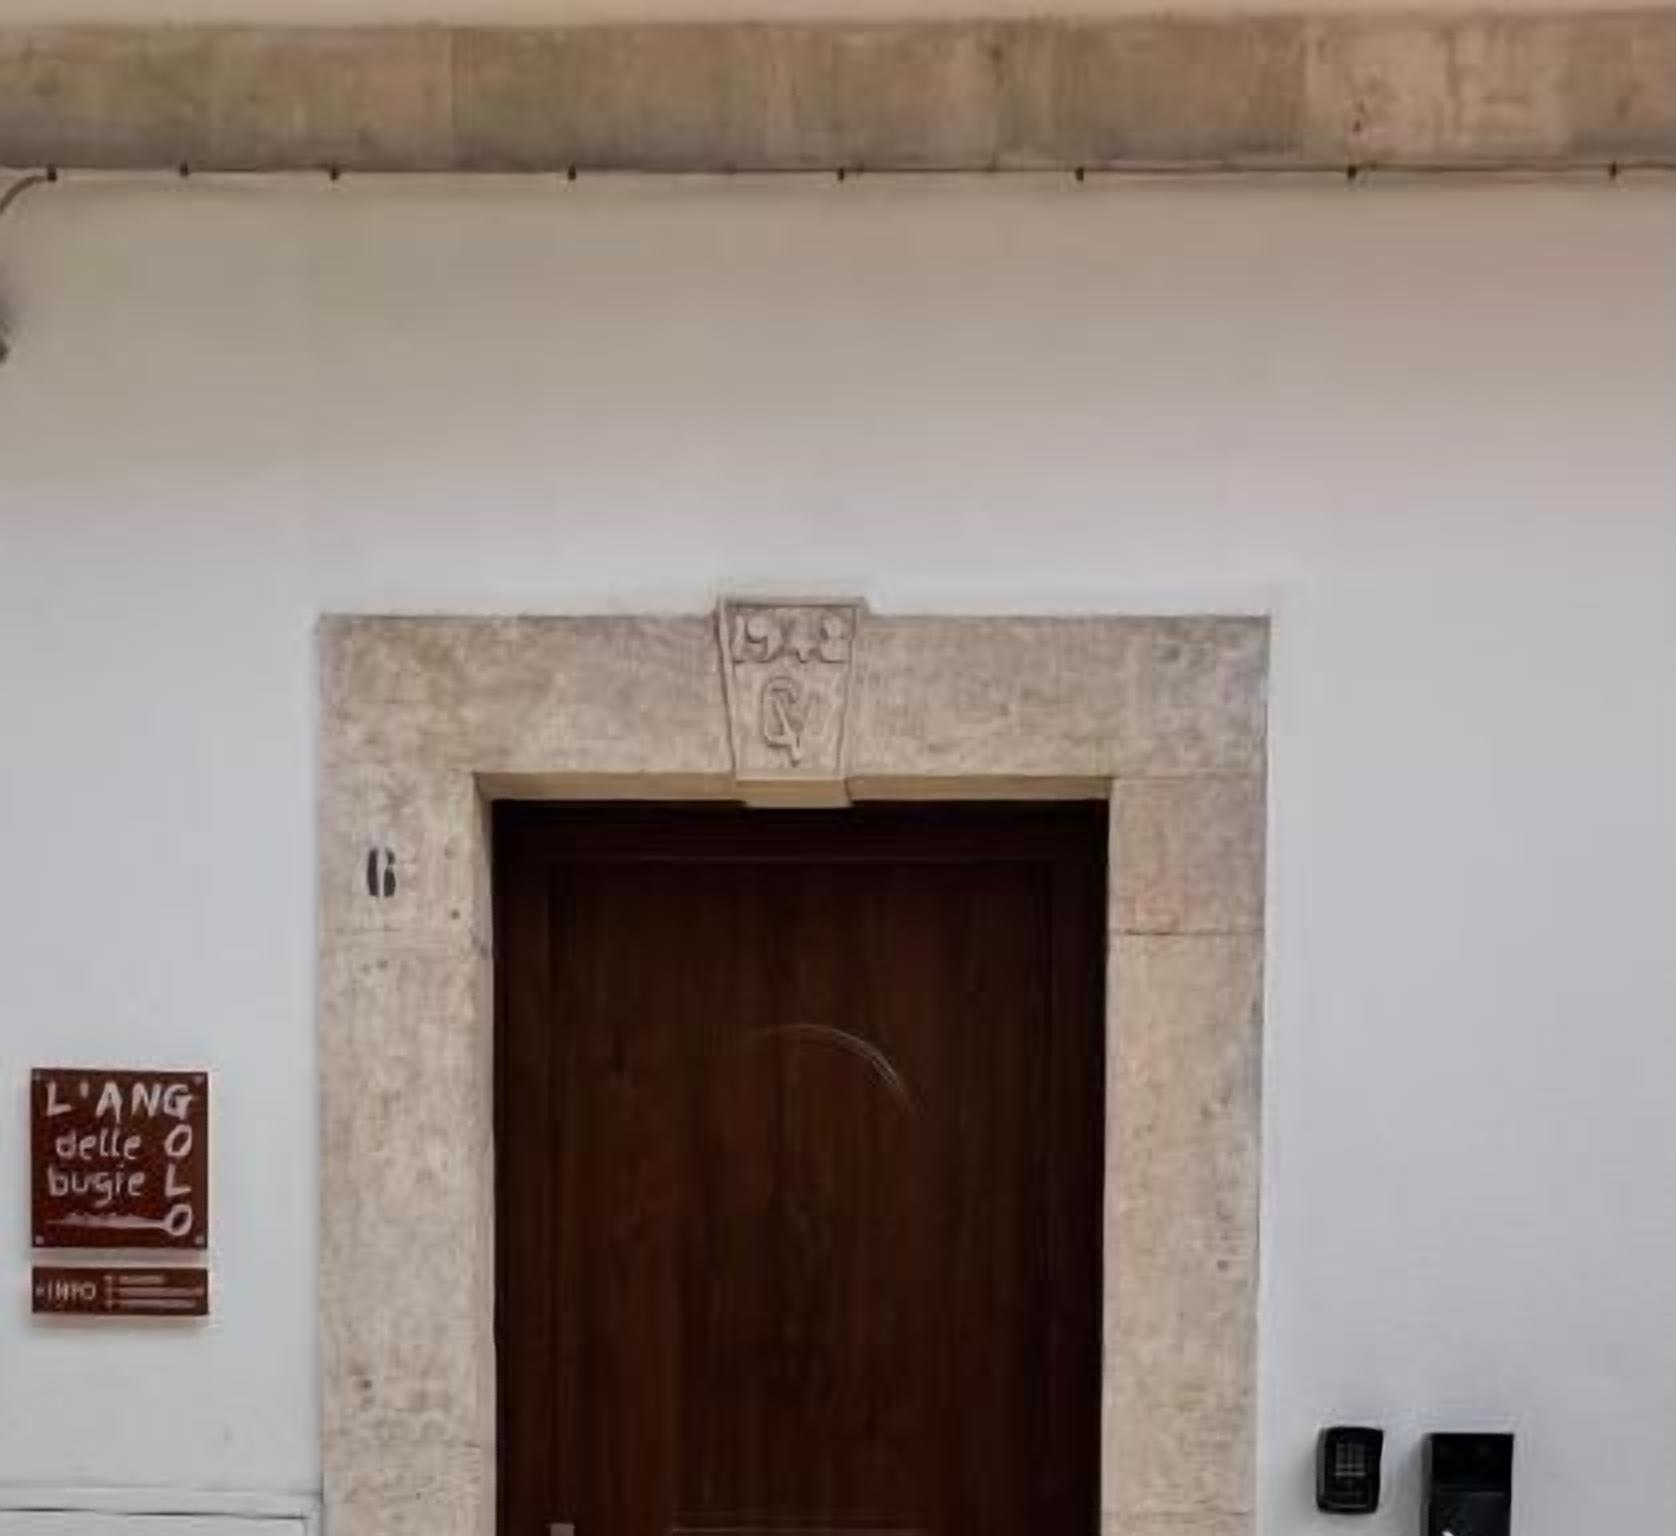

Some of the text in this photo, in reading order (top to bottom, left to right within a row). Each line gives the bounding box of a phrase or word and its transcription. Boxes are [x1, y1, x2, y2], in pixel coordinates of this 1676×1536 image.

[733, 612, 852, 664] 1948
[366, 846, 396, 897] 6
[55, 1128, 142, 1160] delle
[47, 1163, 146, 1208] bugie
